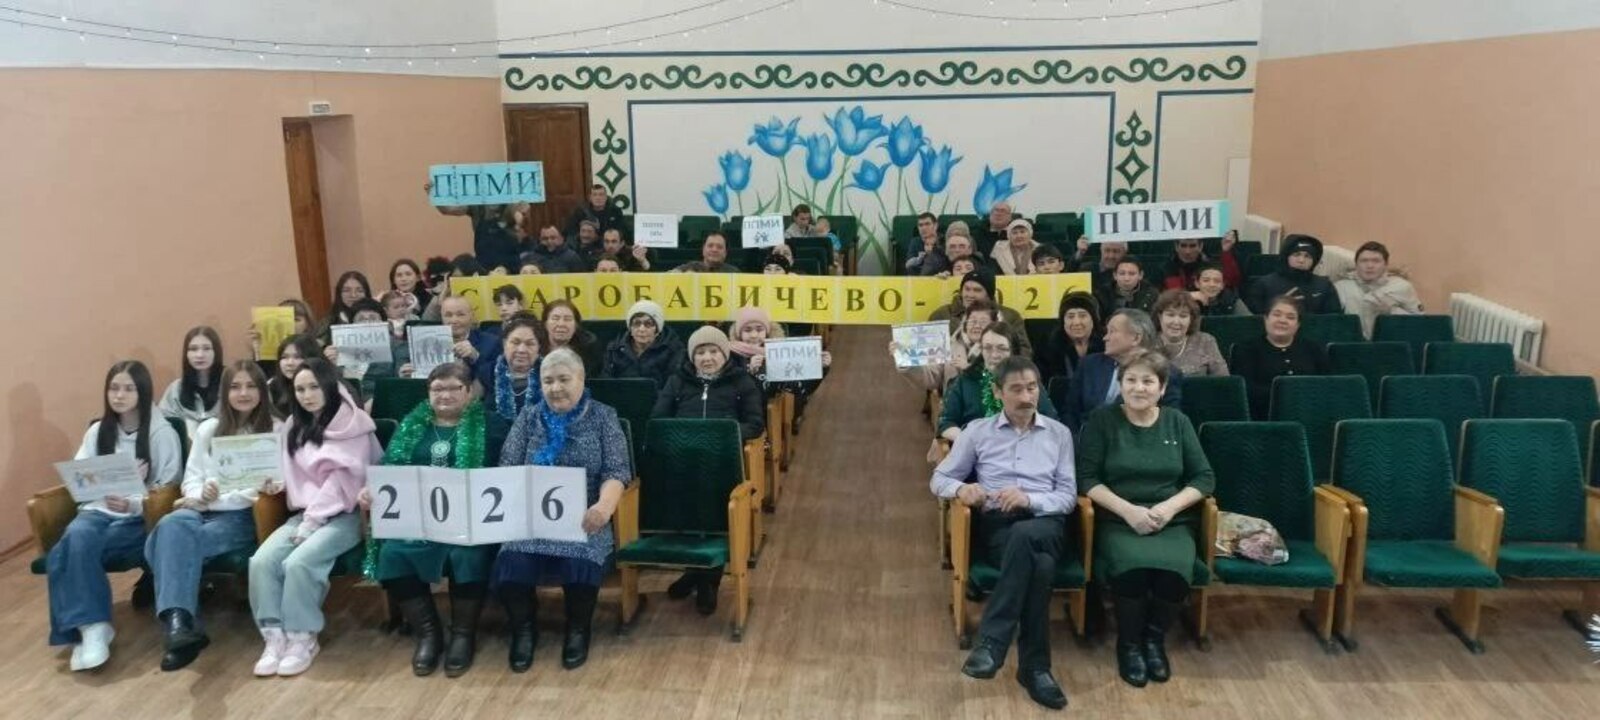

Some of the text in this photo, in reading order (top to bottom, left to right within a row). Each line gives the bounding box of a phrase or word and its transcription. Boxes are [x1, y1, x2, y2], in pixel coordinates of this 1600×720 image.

[433, 171, 537, 198] ППМИ
[744, 219, 780, 229] ППМИ
[1099, 207, 1213, 234] ППМИ
[336, 331, 386, 345] ППМИ
[768, 345, 817, 359] ППМИ
[378, 484, 565, 523] 2026
